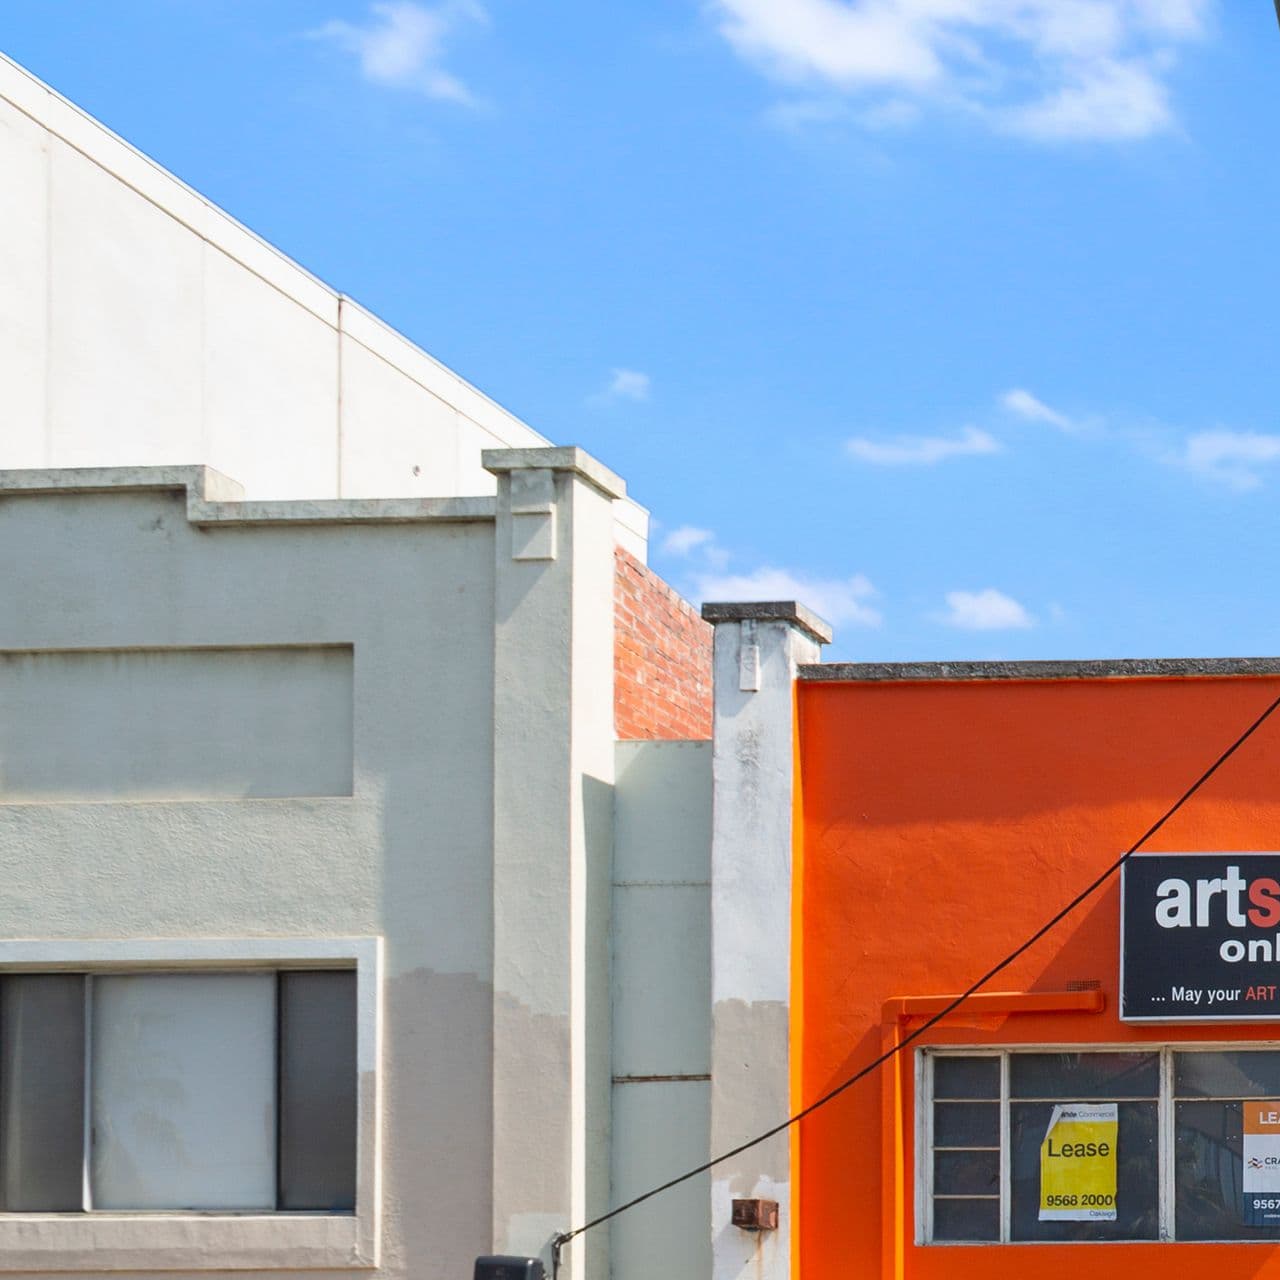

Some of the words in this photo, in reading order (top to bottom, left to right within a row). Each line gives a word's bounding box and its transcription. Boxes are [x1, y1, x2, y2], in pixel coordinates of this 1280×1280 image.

[1172, 986, 1203, 1005] May
[1208, 989, 1241, 1005] your
[1245, 986, 1277, 1001] ART
[1047, 1139, 1110, 1158] Lease
[1046, 1194, 1078, 1207] 9568
[1080, 1194, 1113, 1206] 2000
